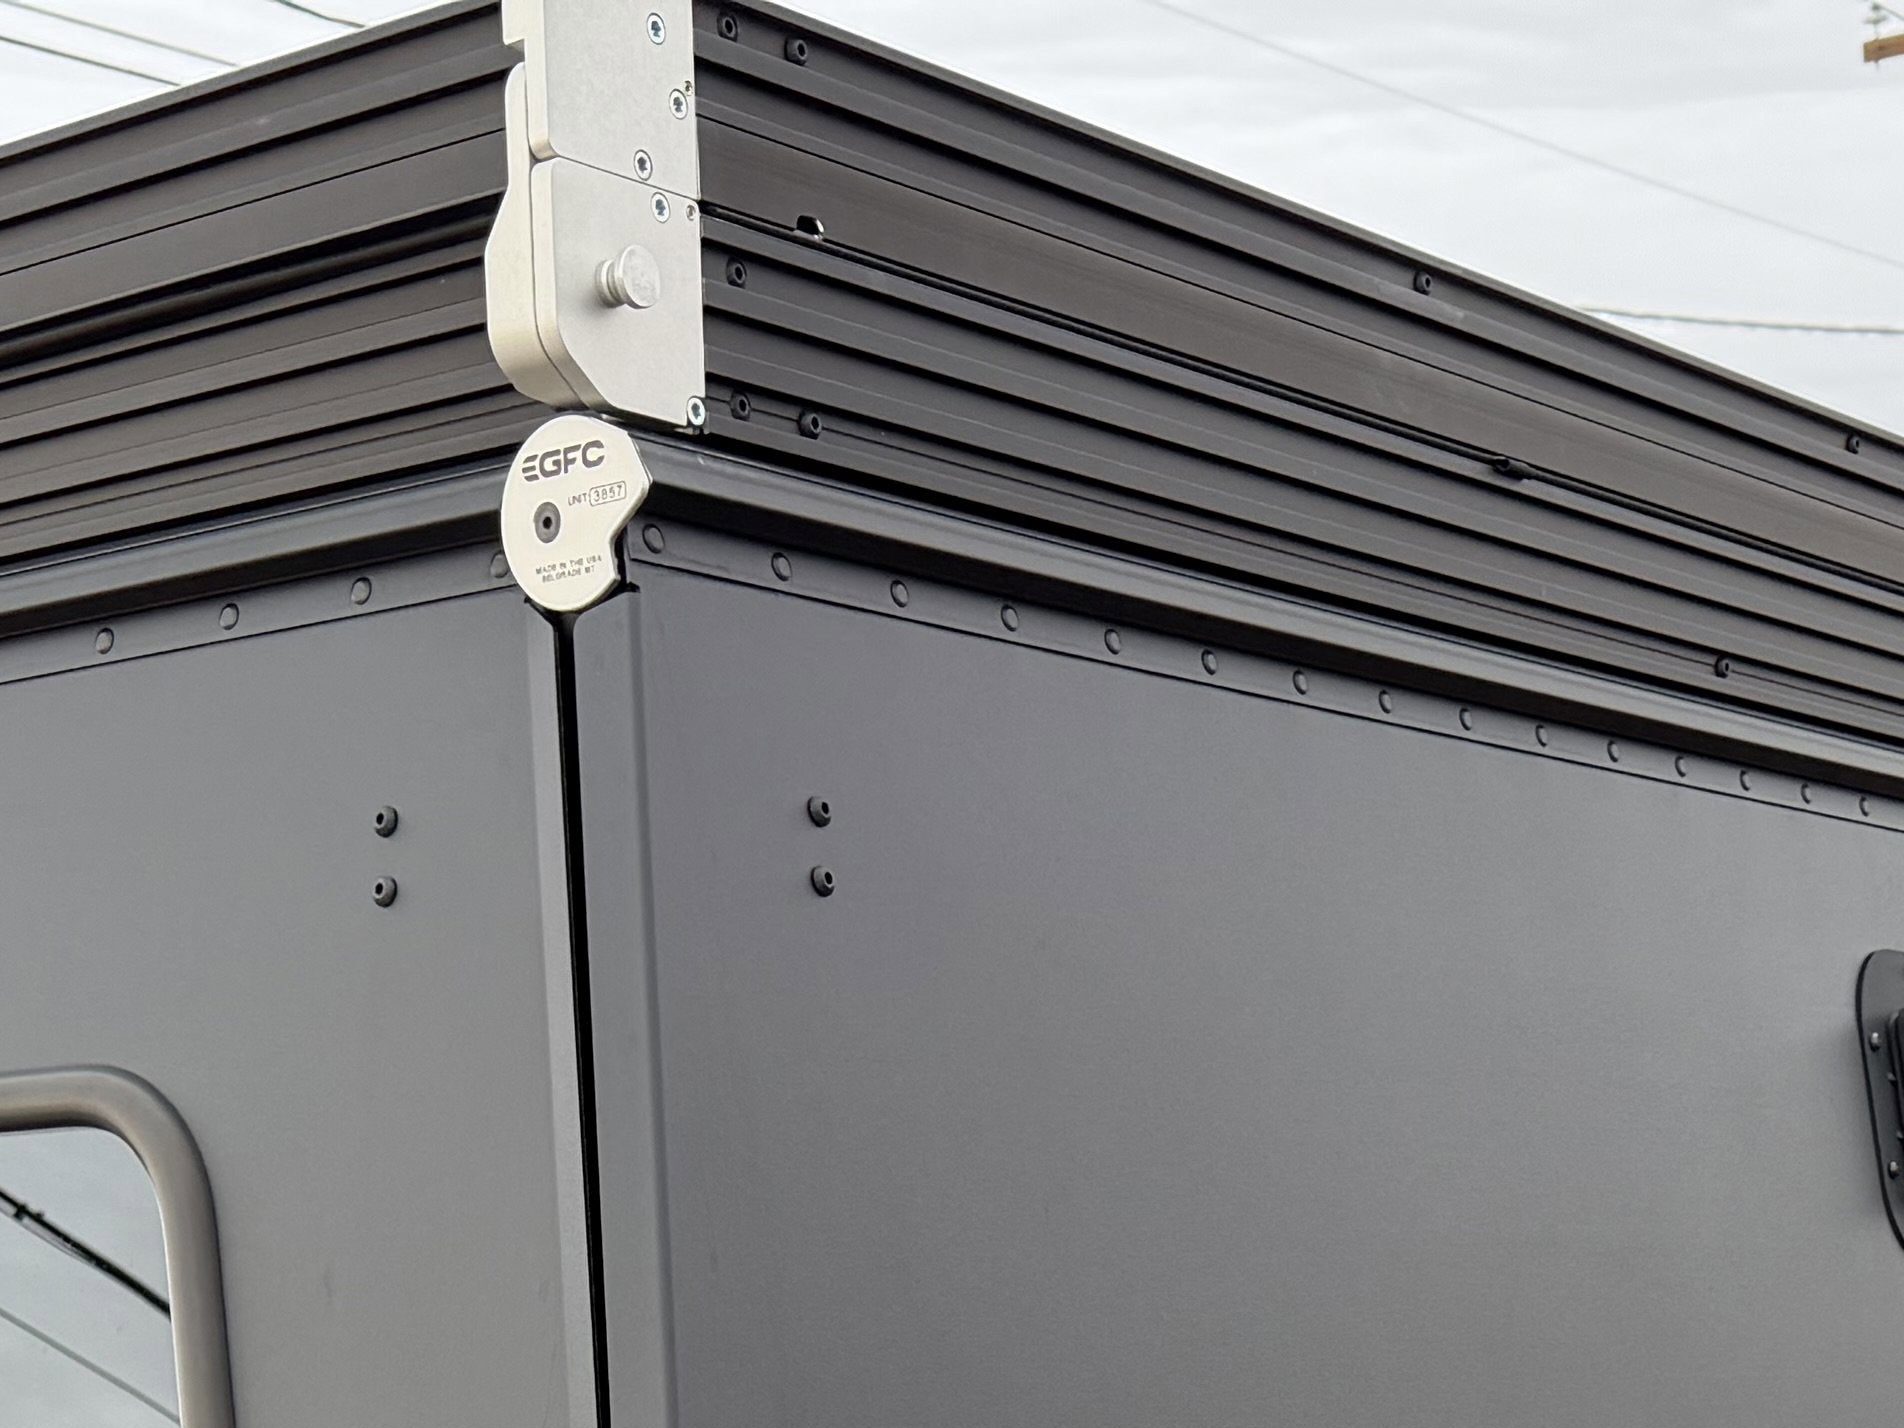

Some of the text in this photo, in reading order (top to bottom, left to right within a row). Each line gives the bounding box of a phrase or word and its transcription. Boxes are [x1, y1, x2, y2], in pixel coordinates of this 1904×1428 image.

[593, 485, 622, 502] 3857
[536, 564, 556, 574] MADE
[570, 558, 583, 567] THE
[587, 555, 601, 564] USA
[542, 568, 581, 582] BELGRADE
